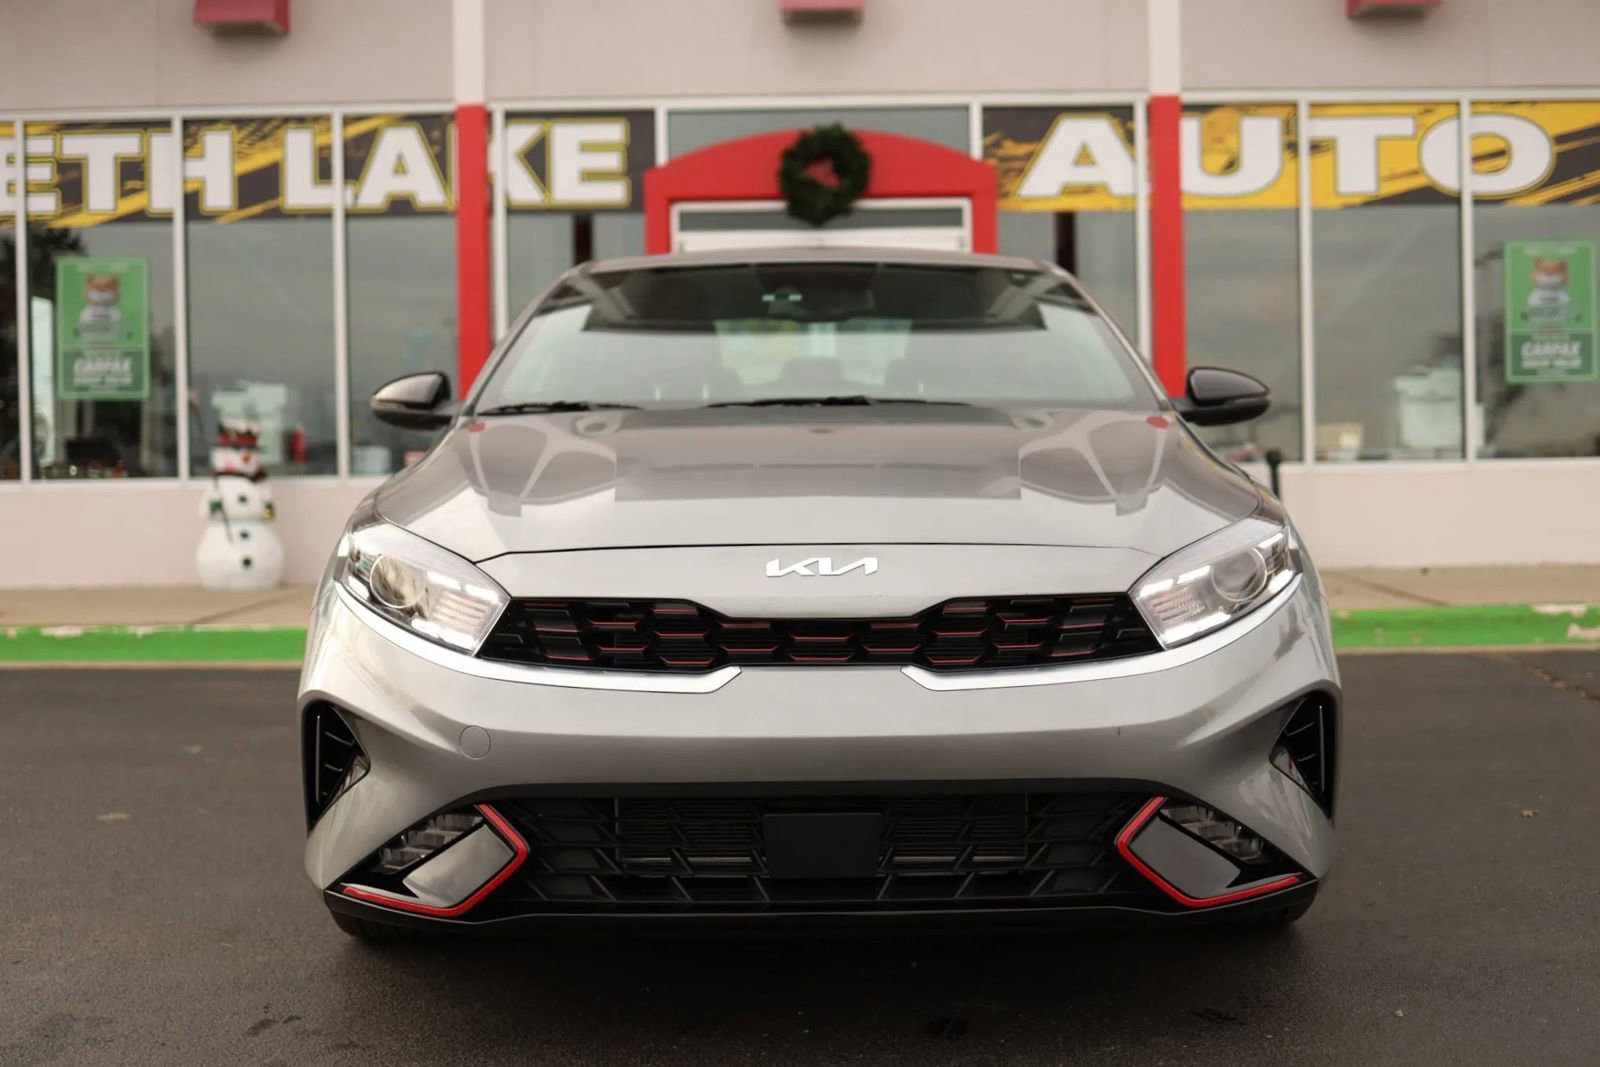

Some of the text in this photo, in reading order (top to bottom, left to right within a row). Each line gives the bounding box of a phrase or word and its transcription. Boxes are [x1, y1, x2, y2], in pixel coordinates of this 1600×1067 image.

[281, 118, 631, 212] LAKE
[1017, 112, 1556, 198] AUTO
[766, 557, 878, 577] KIA
